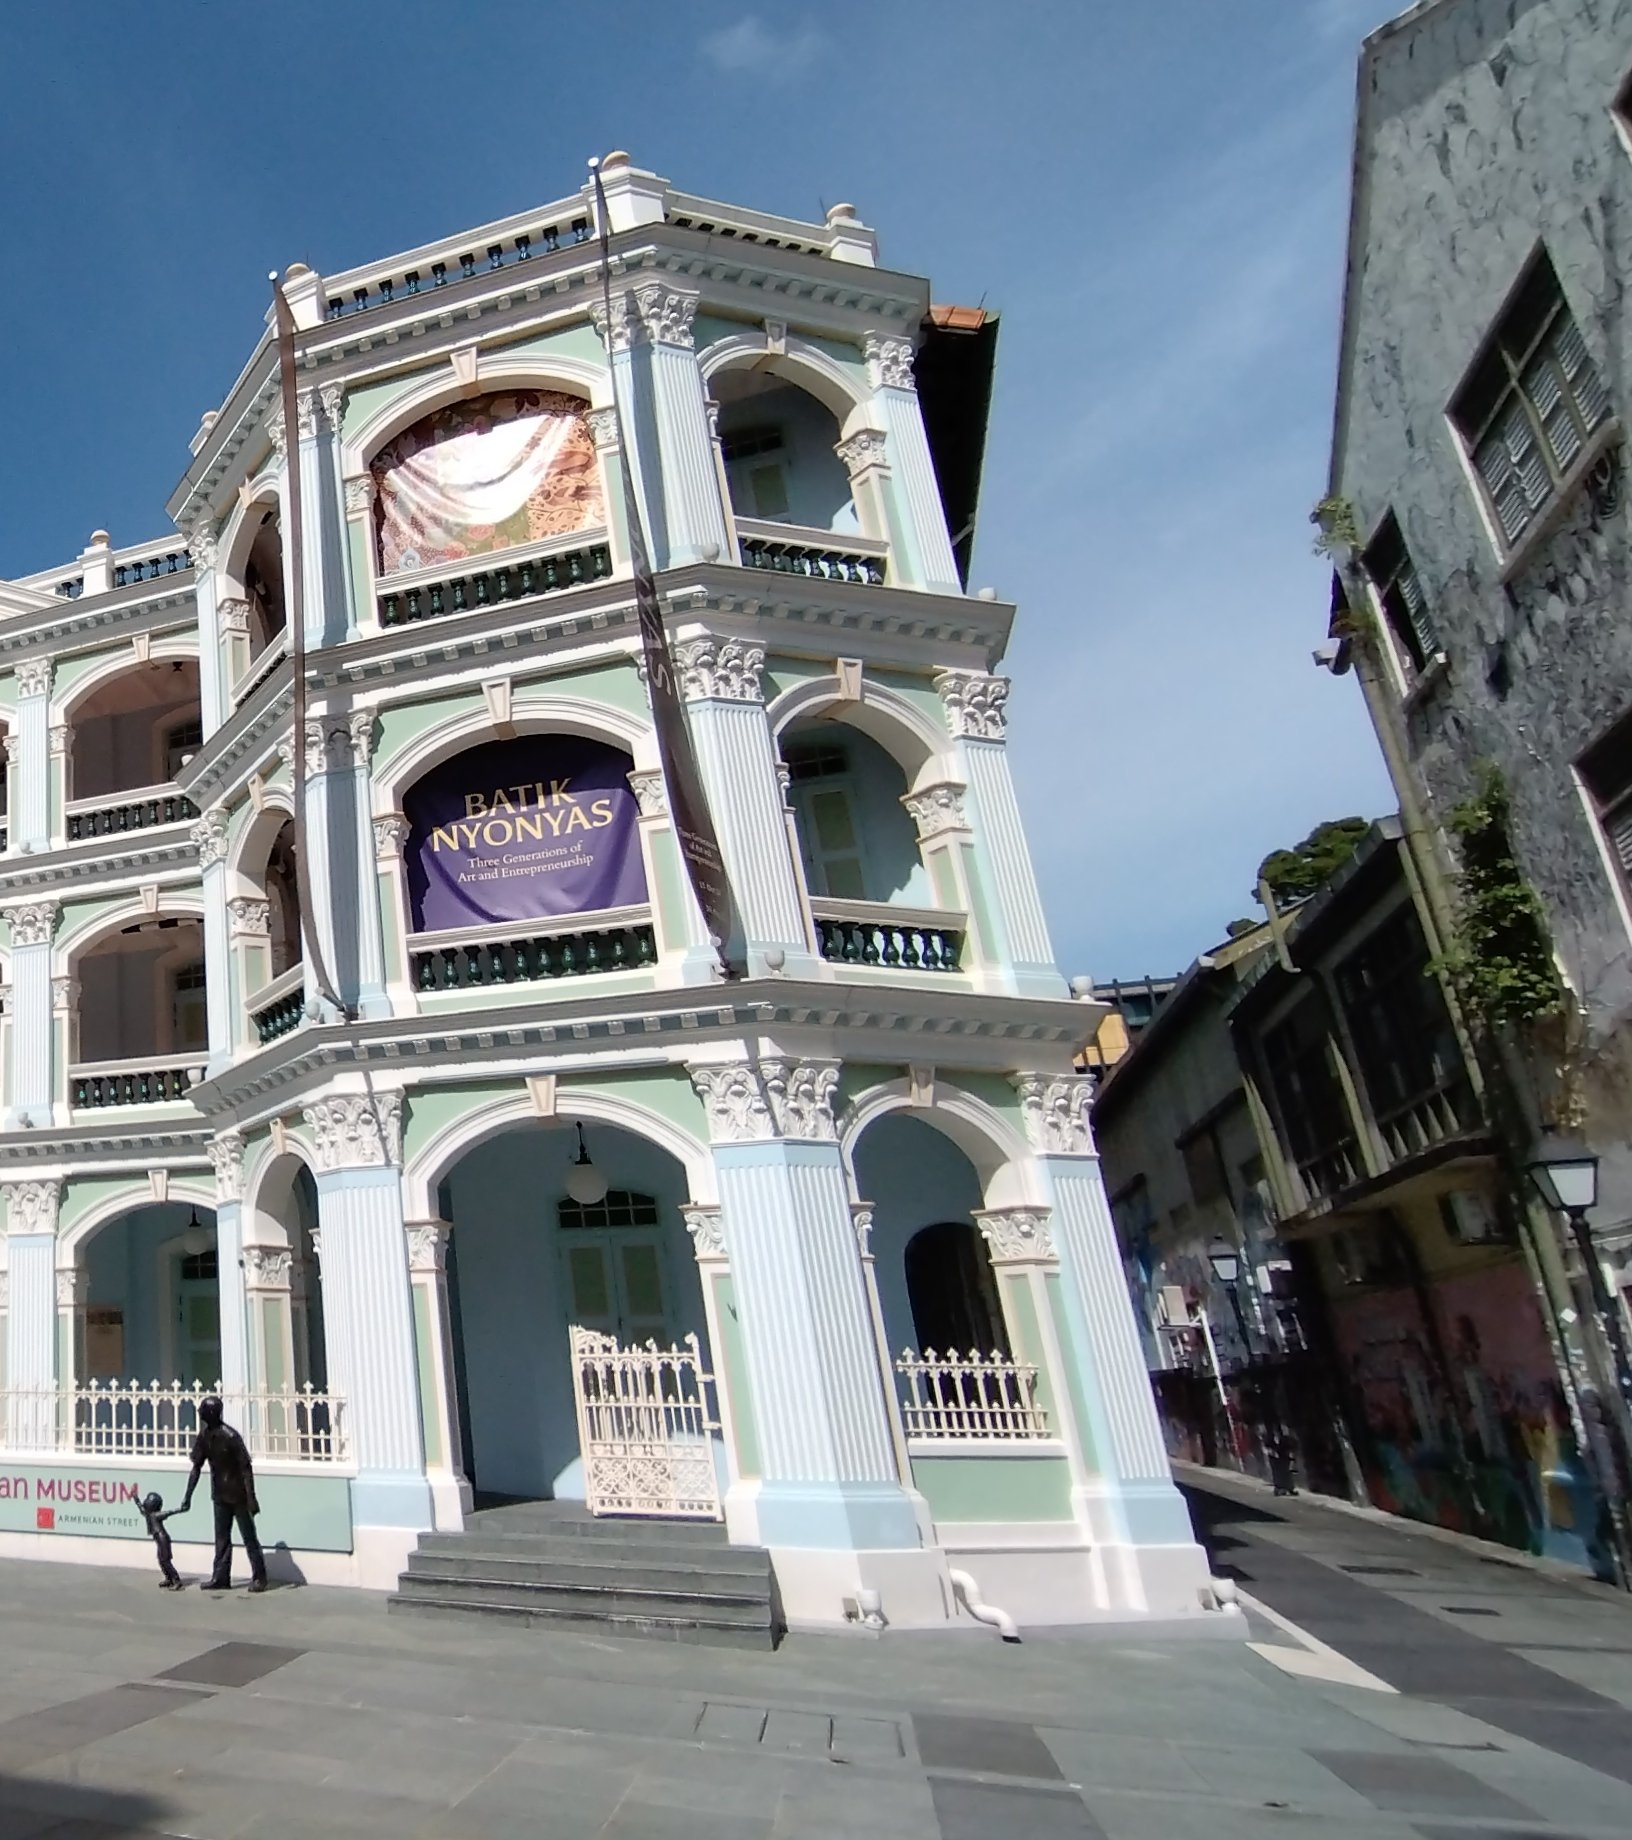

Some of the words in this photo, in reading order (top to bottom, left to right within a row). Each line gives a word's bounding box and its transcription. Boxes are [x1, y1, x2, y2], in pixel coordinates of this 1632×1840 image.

[464, 778, 577, 820] BATIK
[431, 799, 613, 852] NYONYAS
[458, 872, 476, 883] Art
[478, 868, 499, 880] and
[501, 853, 594, 878] Entrepreneurship
[467, 857, 500, 869] Three
[503, 846, 568, 865] Generations
[570, 840, 583, 854] of
[36, 1478, 138, 1504] MUSEUM
[58, 1514, 104, 1526] ARMENIAN
[107, 1516, 139, 1527] STREET
